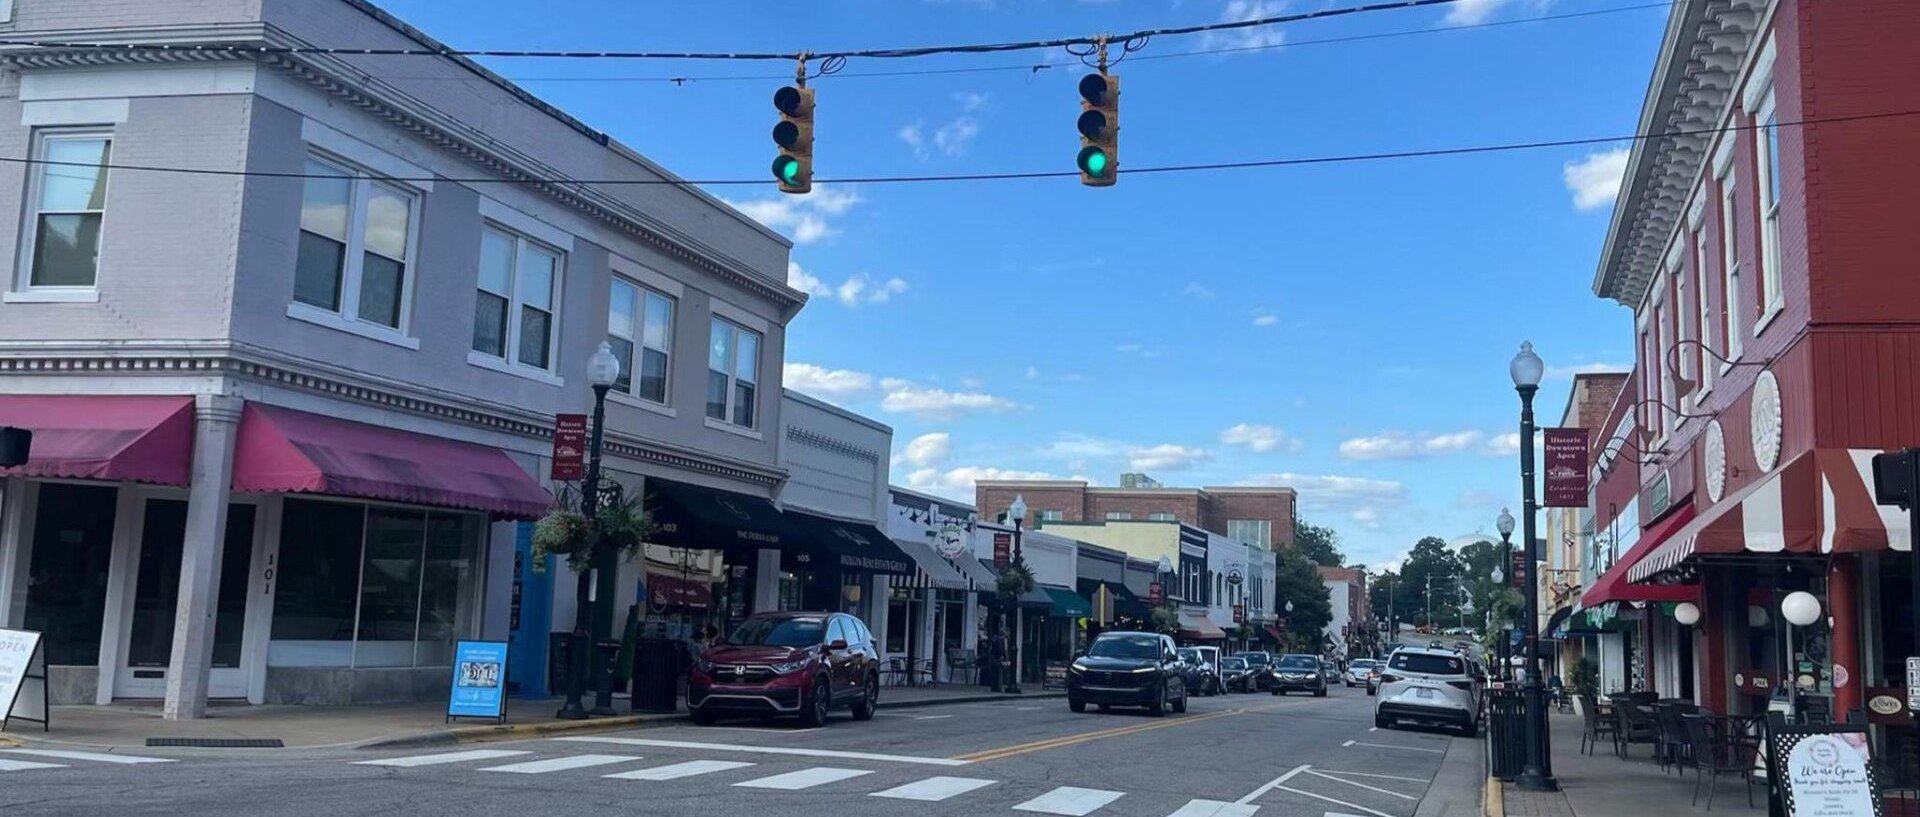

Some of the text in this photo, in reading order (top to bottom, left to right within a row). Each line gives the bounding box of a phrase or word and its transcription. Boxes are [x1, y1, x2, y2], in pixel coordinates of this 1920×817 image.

[1556, 452, 1576, 460] Apex
[662, 523, 678, 533] 103
[264, 553, 274, 595] 101
[1752, 677, 1769, 689] PIZZA
[1801, 765, 1818, 777] We
[1834, 765, 1856, 777] Open
